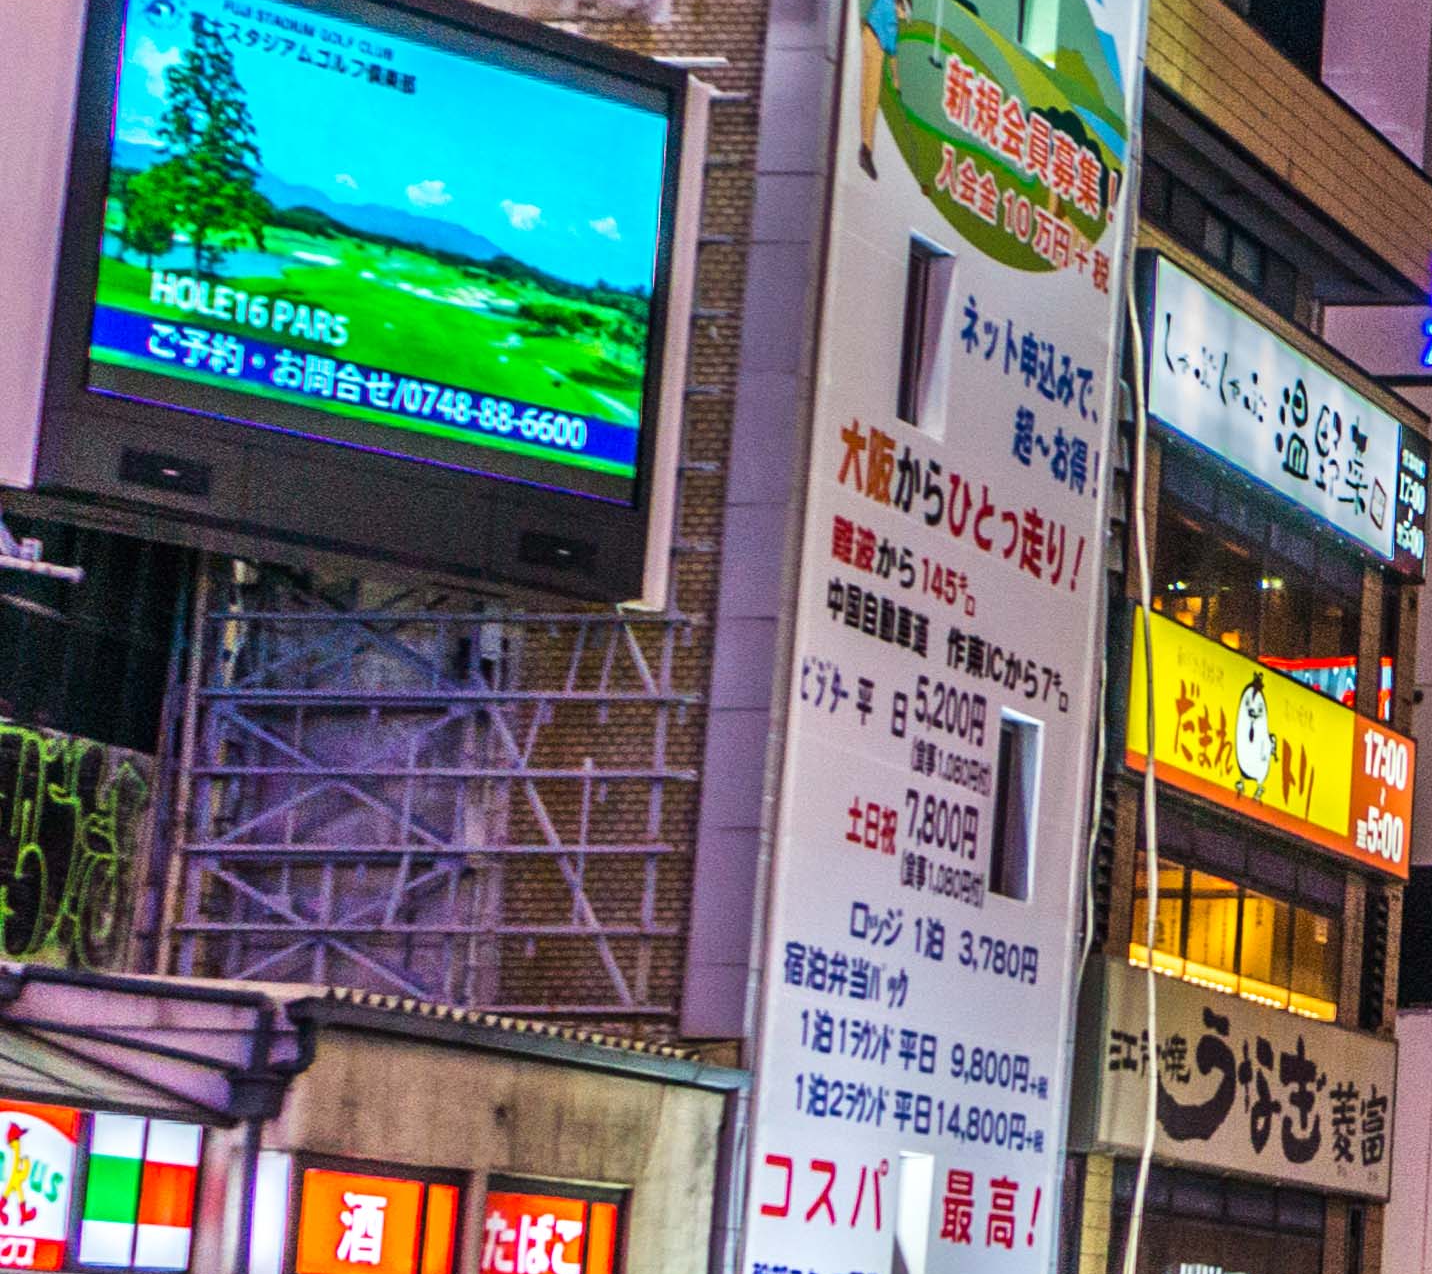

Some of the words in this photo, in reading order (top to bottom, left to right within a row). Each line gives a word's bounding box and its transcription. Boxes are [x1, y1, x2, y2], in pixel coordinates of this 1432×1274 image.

[914, 674, 989, 748] 5,200円
[1363, 727, 1409, 792] 17:00
[905, 787, 981, 862] 7,800円
[958, 929, 1040, 987] 3,780円
[1156, 1005, 1328, 1165] うなぎ
[336, 1191, 389, 1269] 酒
[759, 1152, 890, 1233] コスパ
